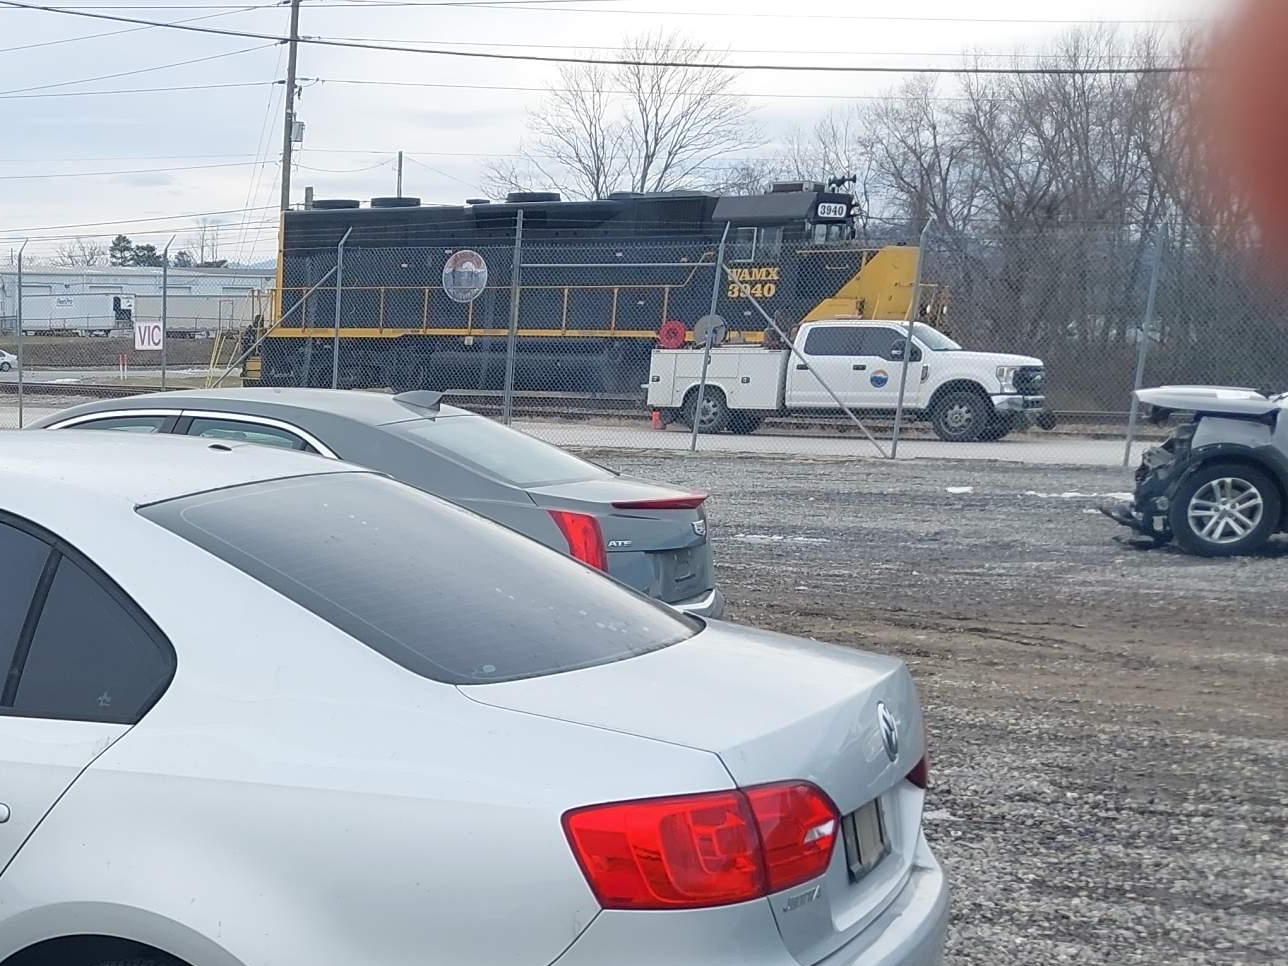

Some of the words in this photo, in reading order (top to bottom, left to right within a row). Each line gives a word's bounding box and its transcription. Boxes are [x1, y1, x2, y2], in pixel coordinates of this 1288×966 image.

[820, 204, 844, 216] 3940
[728, 267, 779, 280] WAMX
[728, 283, 776, 297] 3940
[137, 324, 161, 347] VIC
